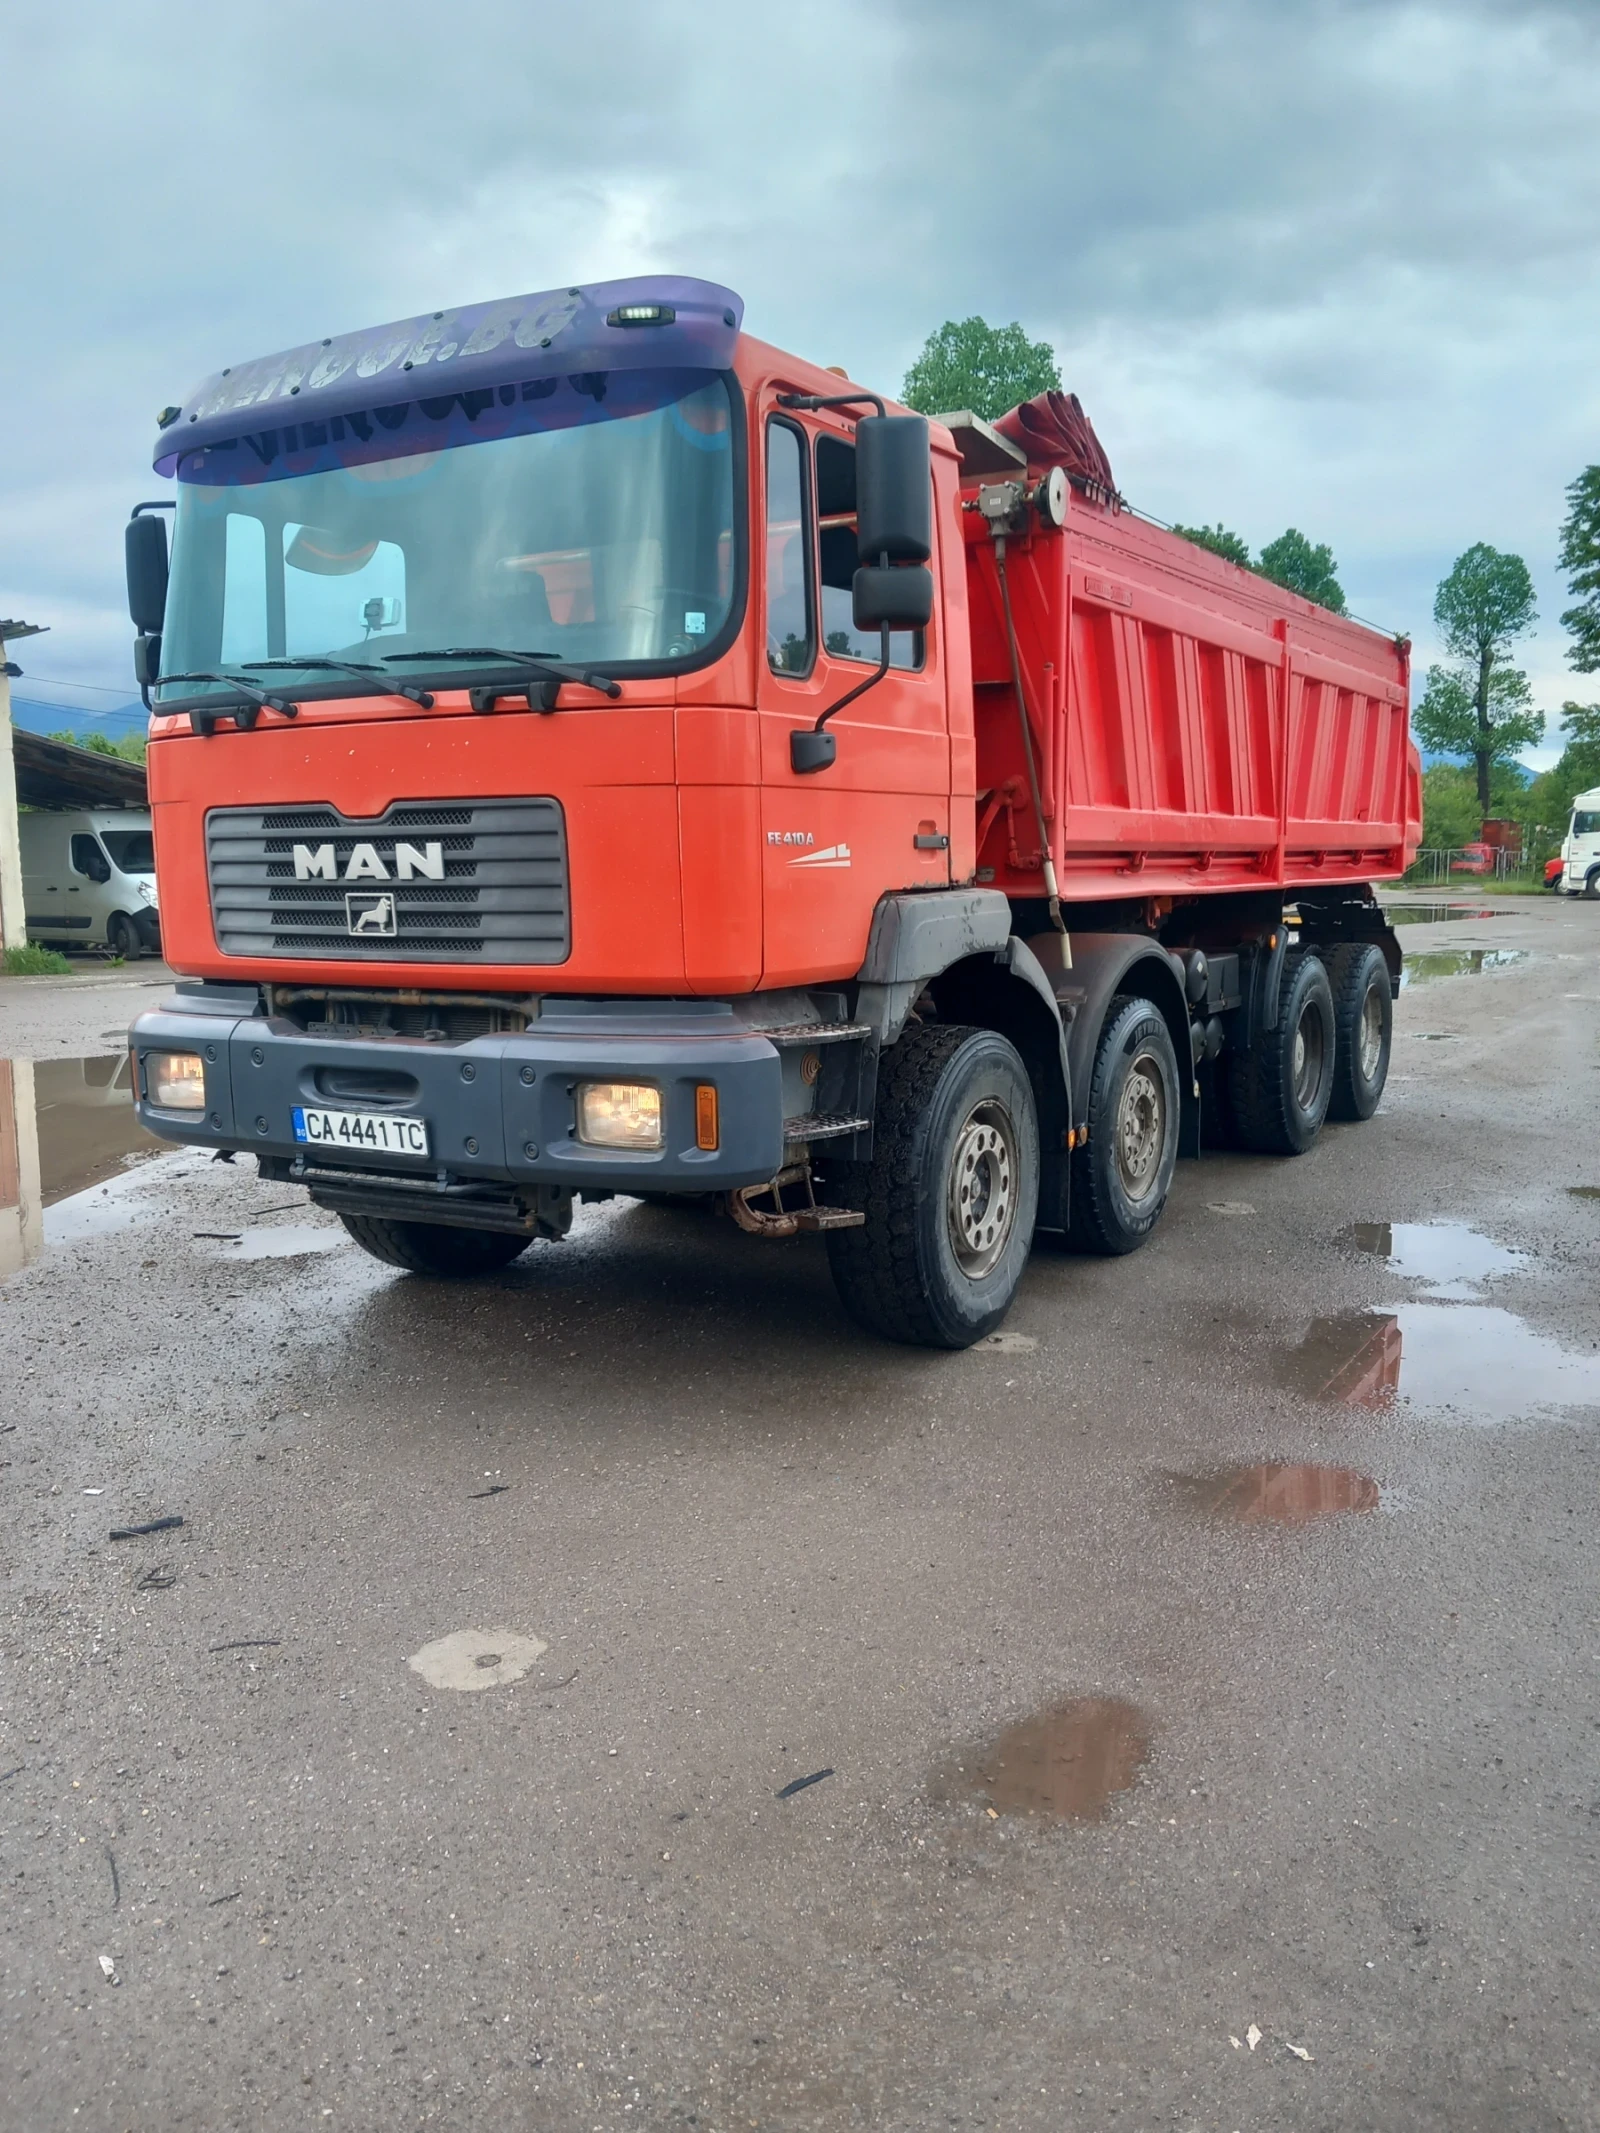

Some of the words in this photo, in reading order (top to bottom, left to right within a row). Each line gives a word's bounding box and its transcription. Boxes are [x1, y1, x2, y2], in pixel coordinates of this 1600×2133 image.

[767, 831, 782, 845] FE
[783, 831, 804, 845] 410
[293, 843, 446, 881] MAN
[296, 1128, 306, 1137] BG
[307, 1113, 335, 1141] CA
[339, 1116, 388, 1147] 4441
[393, 1122, 423, 1150] TC
